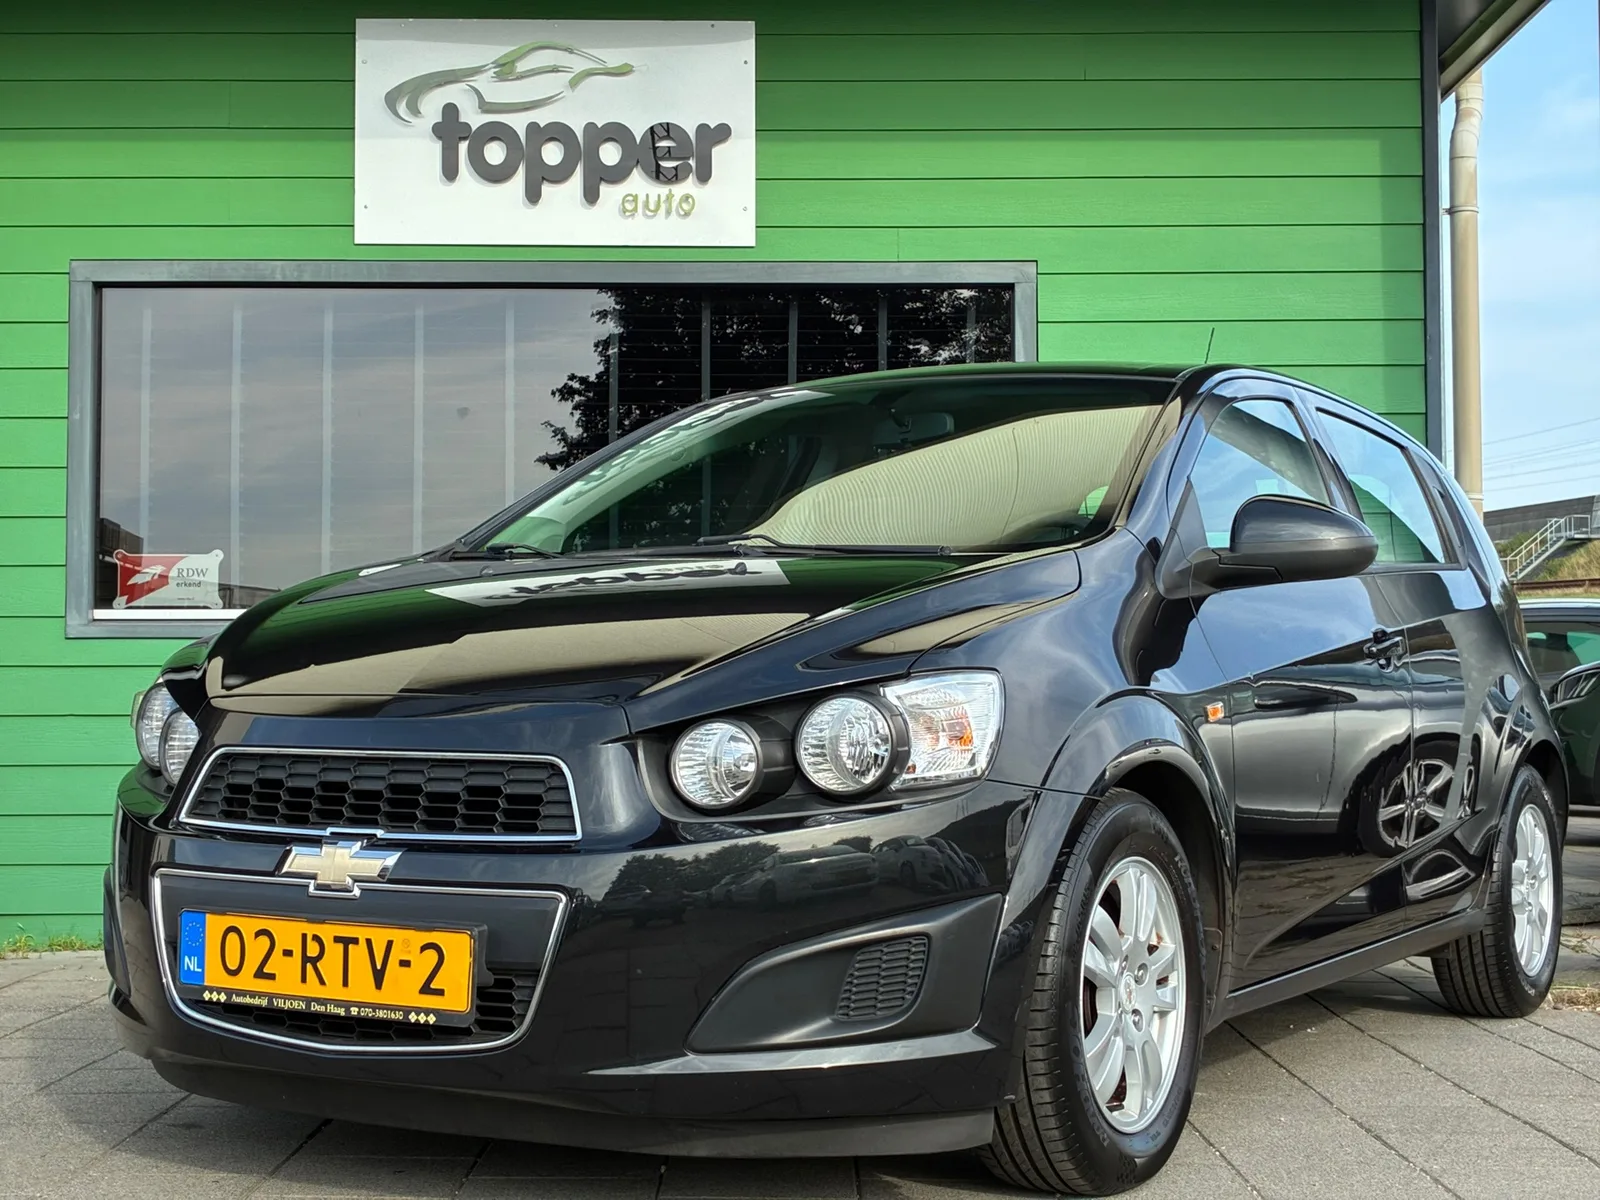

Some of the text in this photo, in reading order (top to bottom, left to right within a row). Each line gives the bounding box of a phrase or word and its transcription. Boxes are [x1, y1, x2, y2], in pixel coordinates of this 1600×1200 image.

[431, 102, 732, 204] topper
[621, 188, 696, 215] auto
[176, 580, 202, 588] erkend
[177, 567, 209, 578] RDW
[184, 954, 203, 973] NL
[219, 925, 446, 997] 02-RTV-2
[231, 993, 404, 1020] Autobedrijf VILJOEN Den Haag 070-3801630
